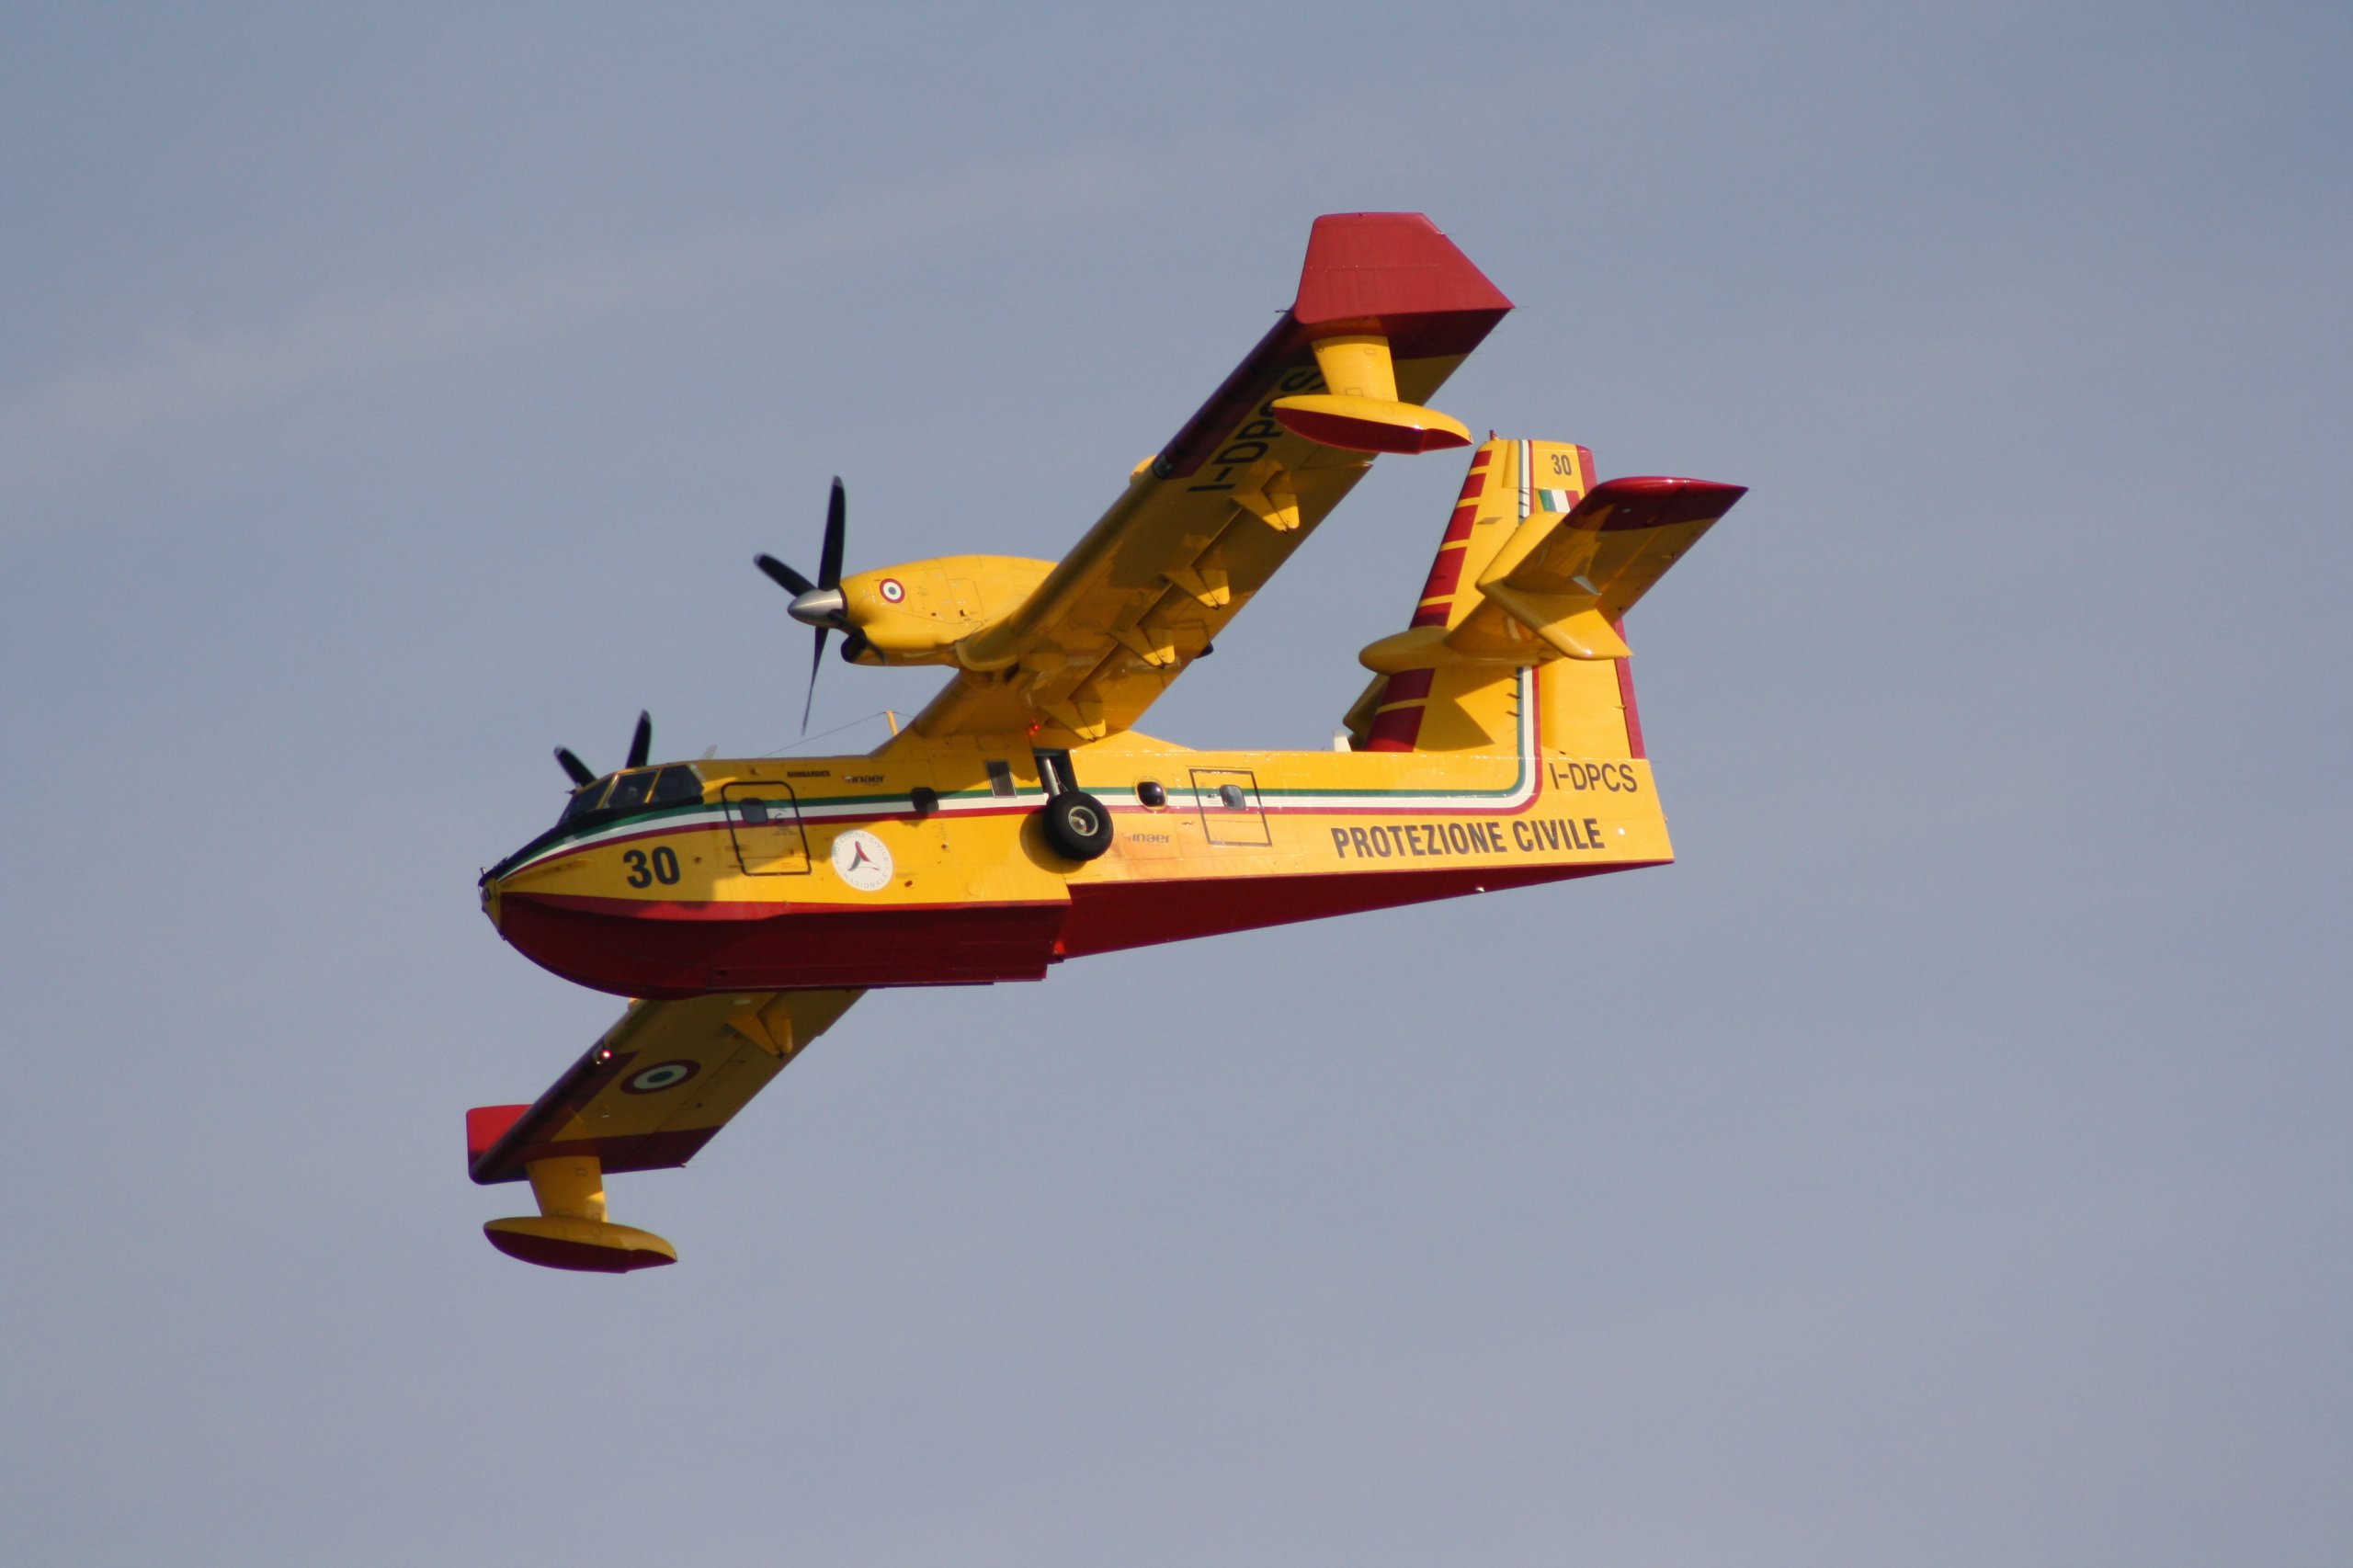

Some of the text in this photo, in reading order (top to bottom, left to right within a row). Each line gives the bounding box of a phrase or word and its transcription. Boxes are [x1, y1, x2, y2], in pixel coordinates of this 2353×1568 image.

[1551, 453, 1573, 476] 30
[1548, 762, 1638, 793] I-DPCS
[1331, 818, 1606, 858] PROTEZIONE CIVILE
[623, 846, 680, 889] 30
